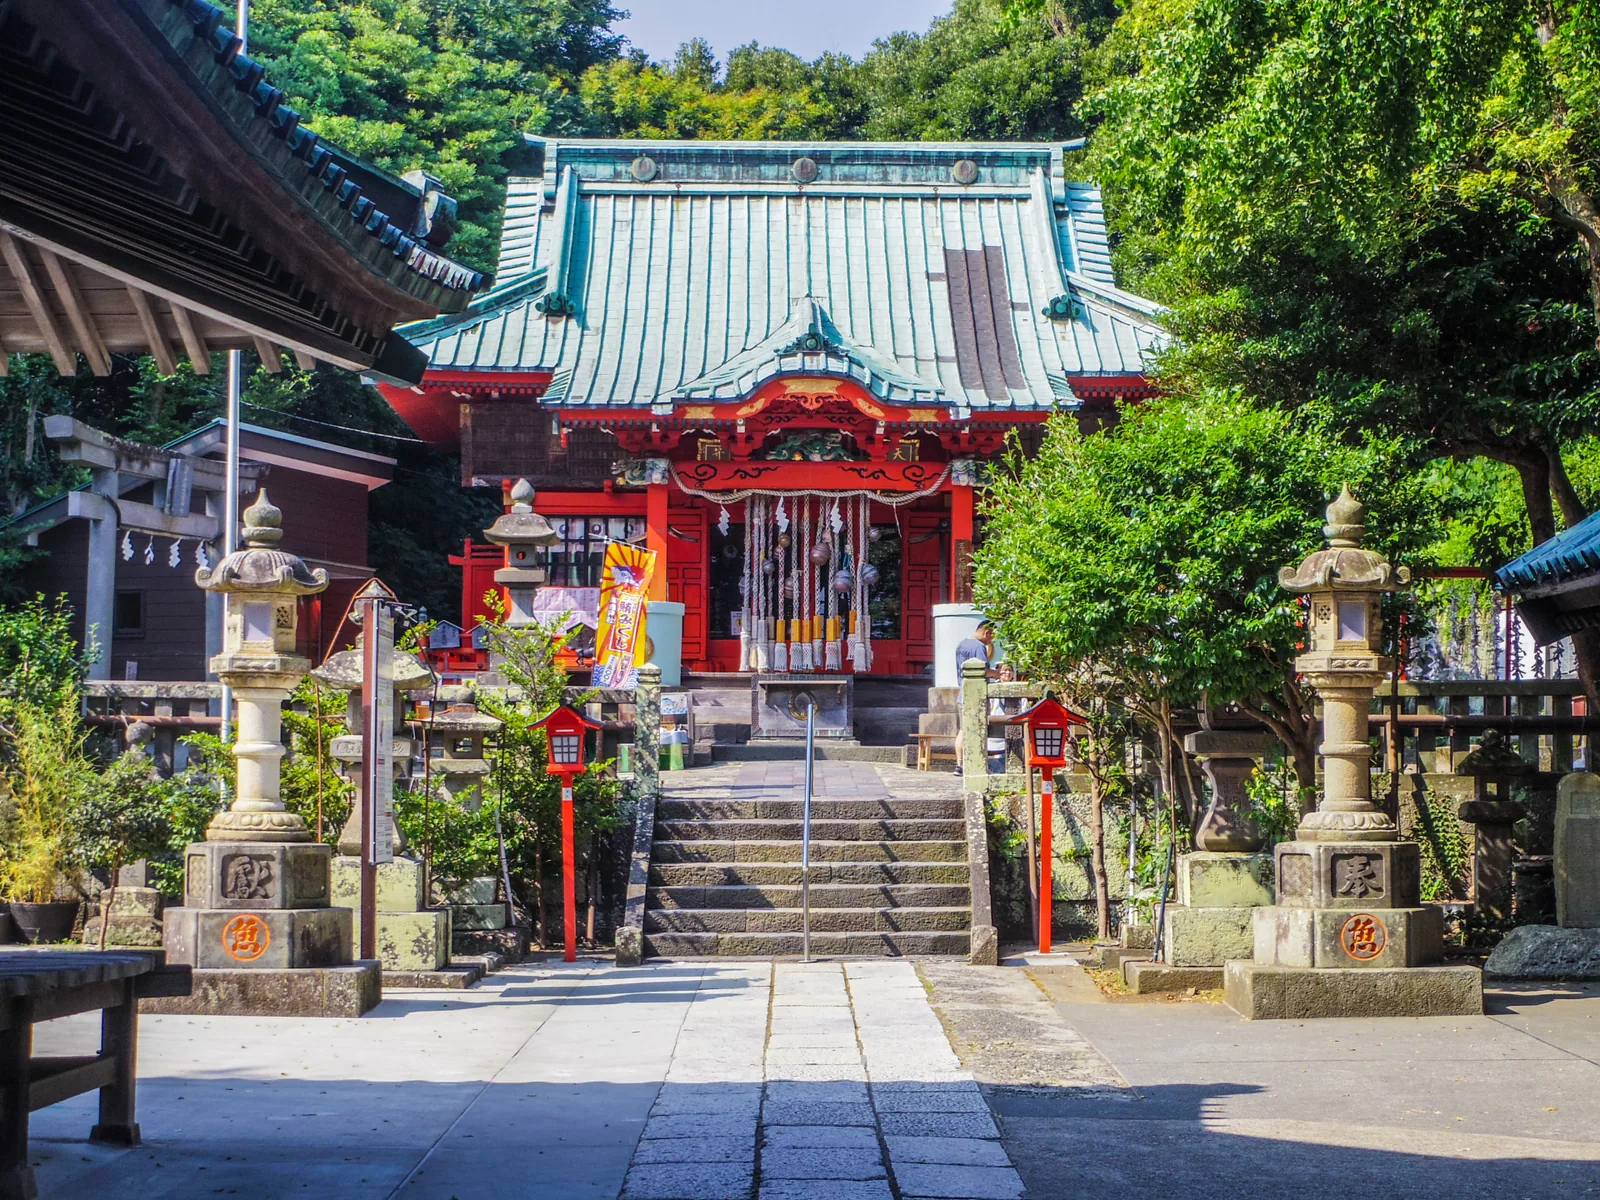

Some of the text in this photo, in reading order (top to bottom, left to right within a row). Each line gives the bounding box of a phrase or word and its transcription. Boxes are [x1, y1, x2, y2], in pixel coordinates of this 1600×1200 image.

[1338, 855, 1384, 899] 奉
[230, 916, 263, 955] 魚
[1347, 916, 1380, 955] 魚
